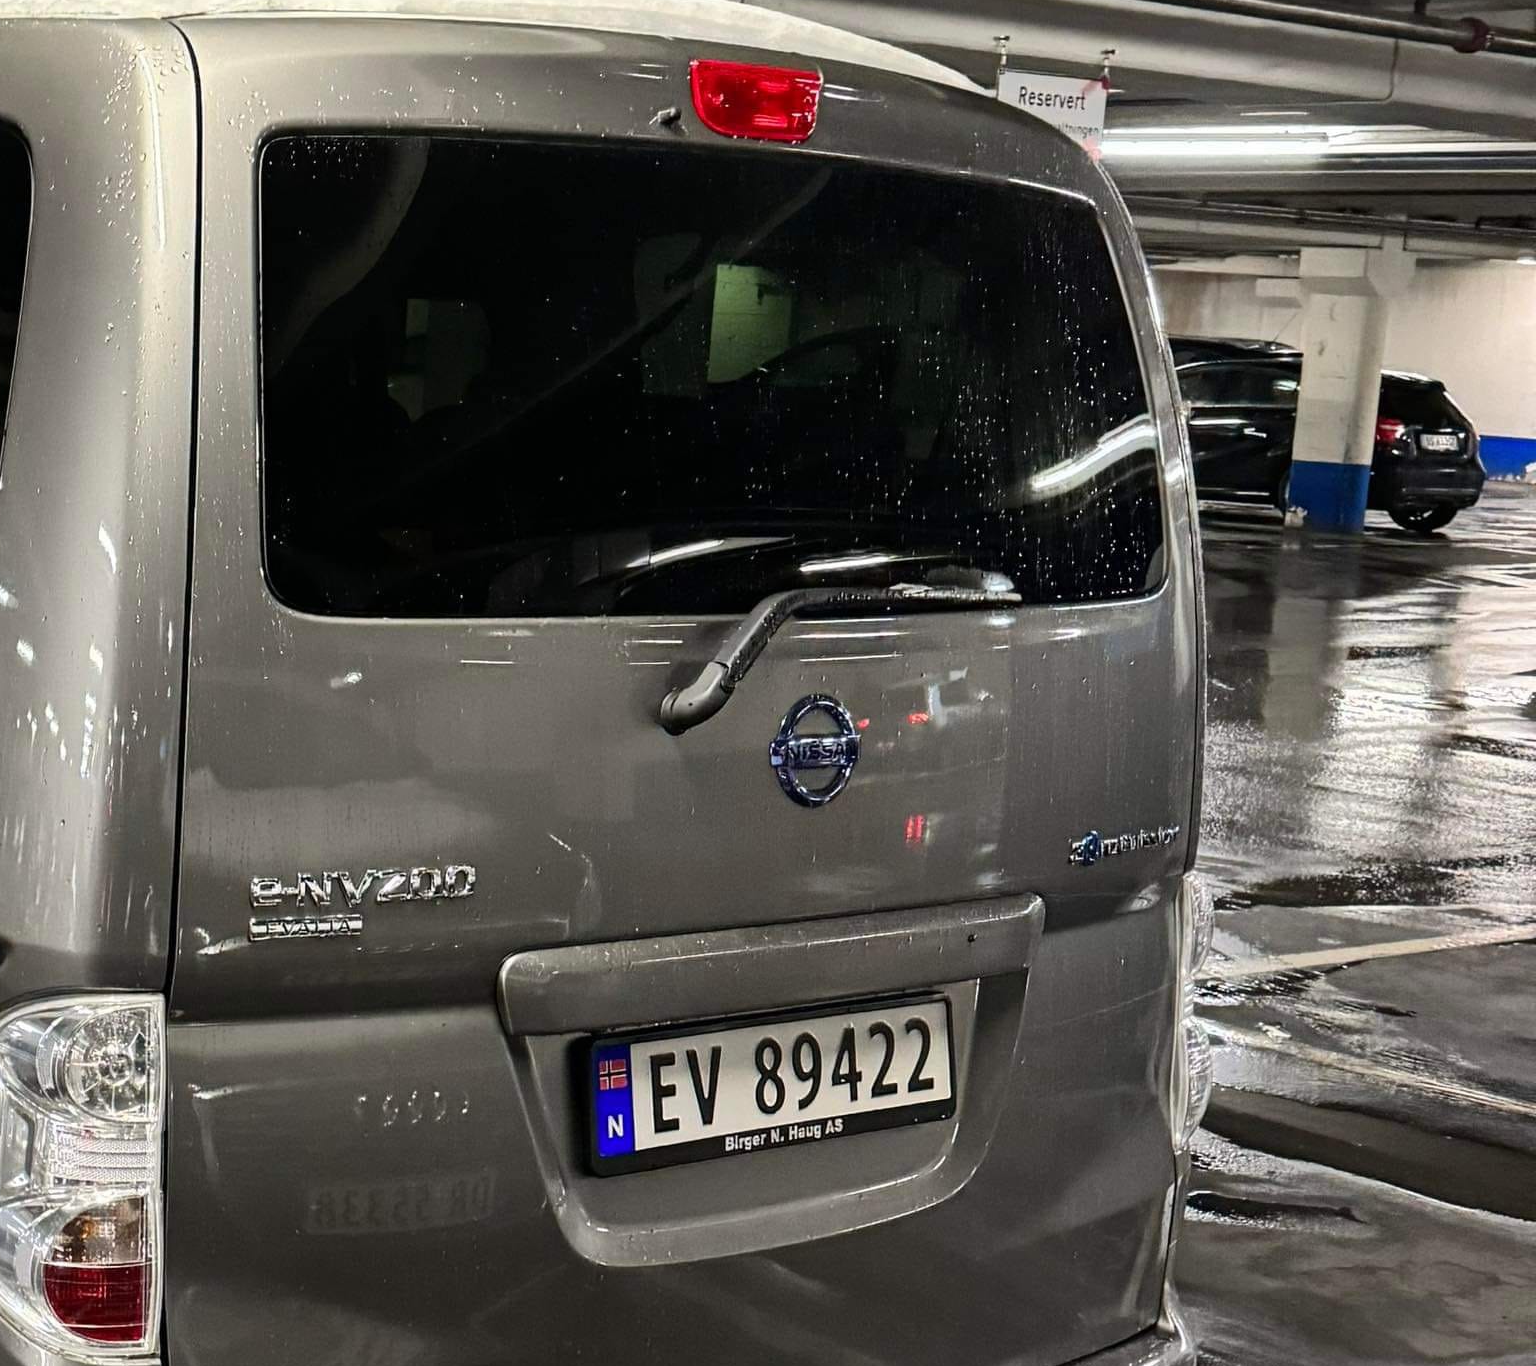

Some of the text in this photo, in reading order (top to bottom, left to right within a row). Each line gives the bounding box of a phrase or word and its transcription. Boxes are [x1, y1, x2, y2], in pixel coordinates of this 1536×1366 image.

[1018, 86, 1086, 110] Reservert
[785, 739, 855, 763] NISSAN
[250, 864, 477, 908] e-NV200
[265, 918, 353, 936] EVALIA
[649, 1017, 936, 1134] EV 89422
[607, 1113, 625, 1139] N
[725, 1118, 844, 1152] Birger N. Haug AS
